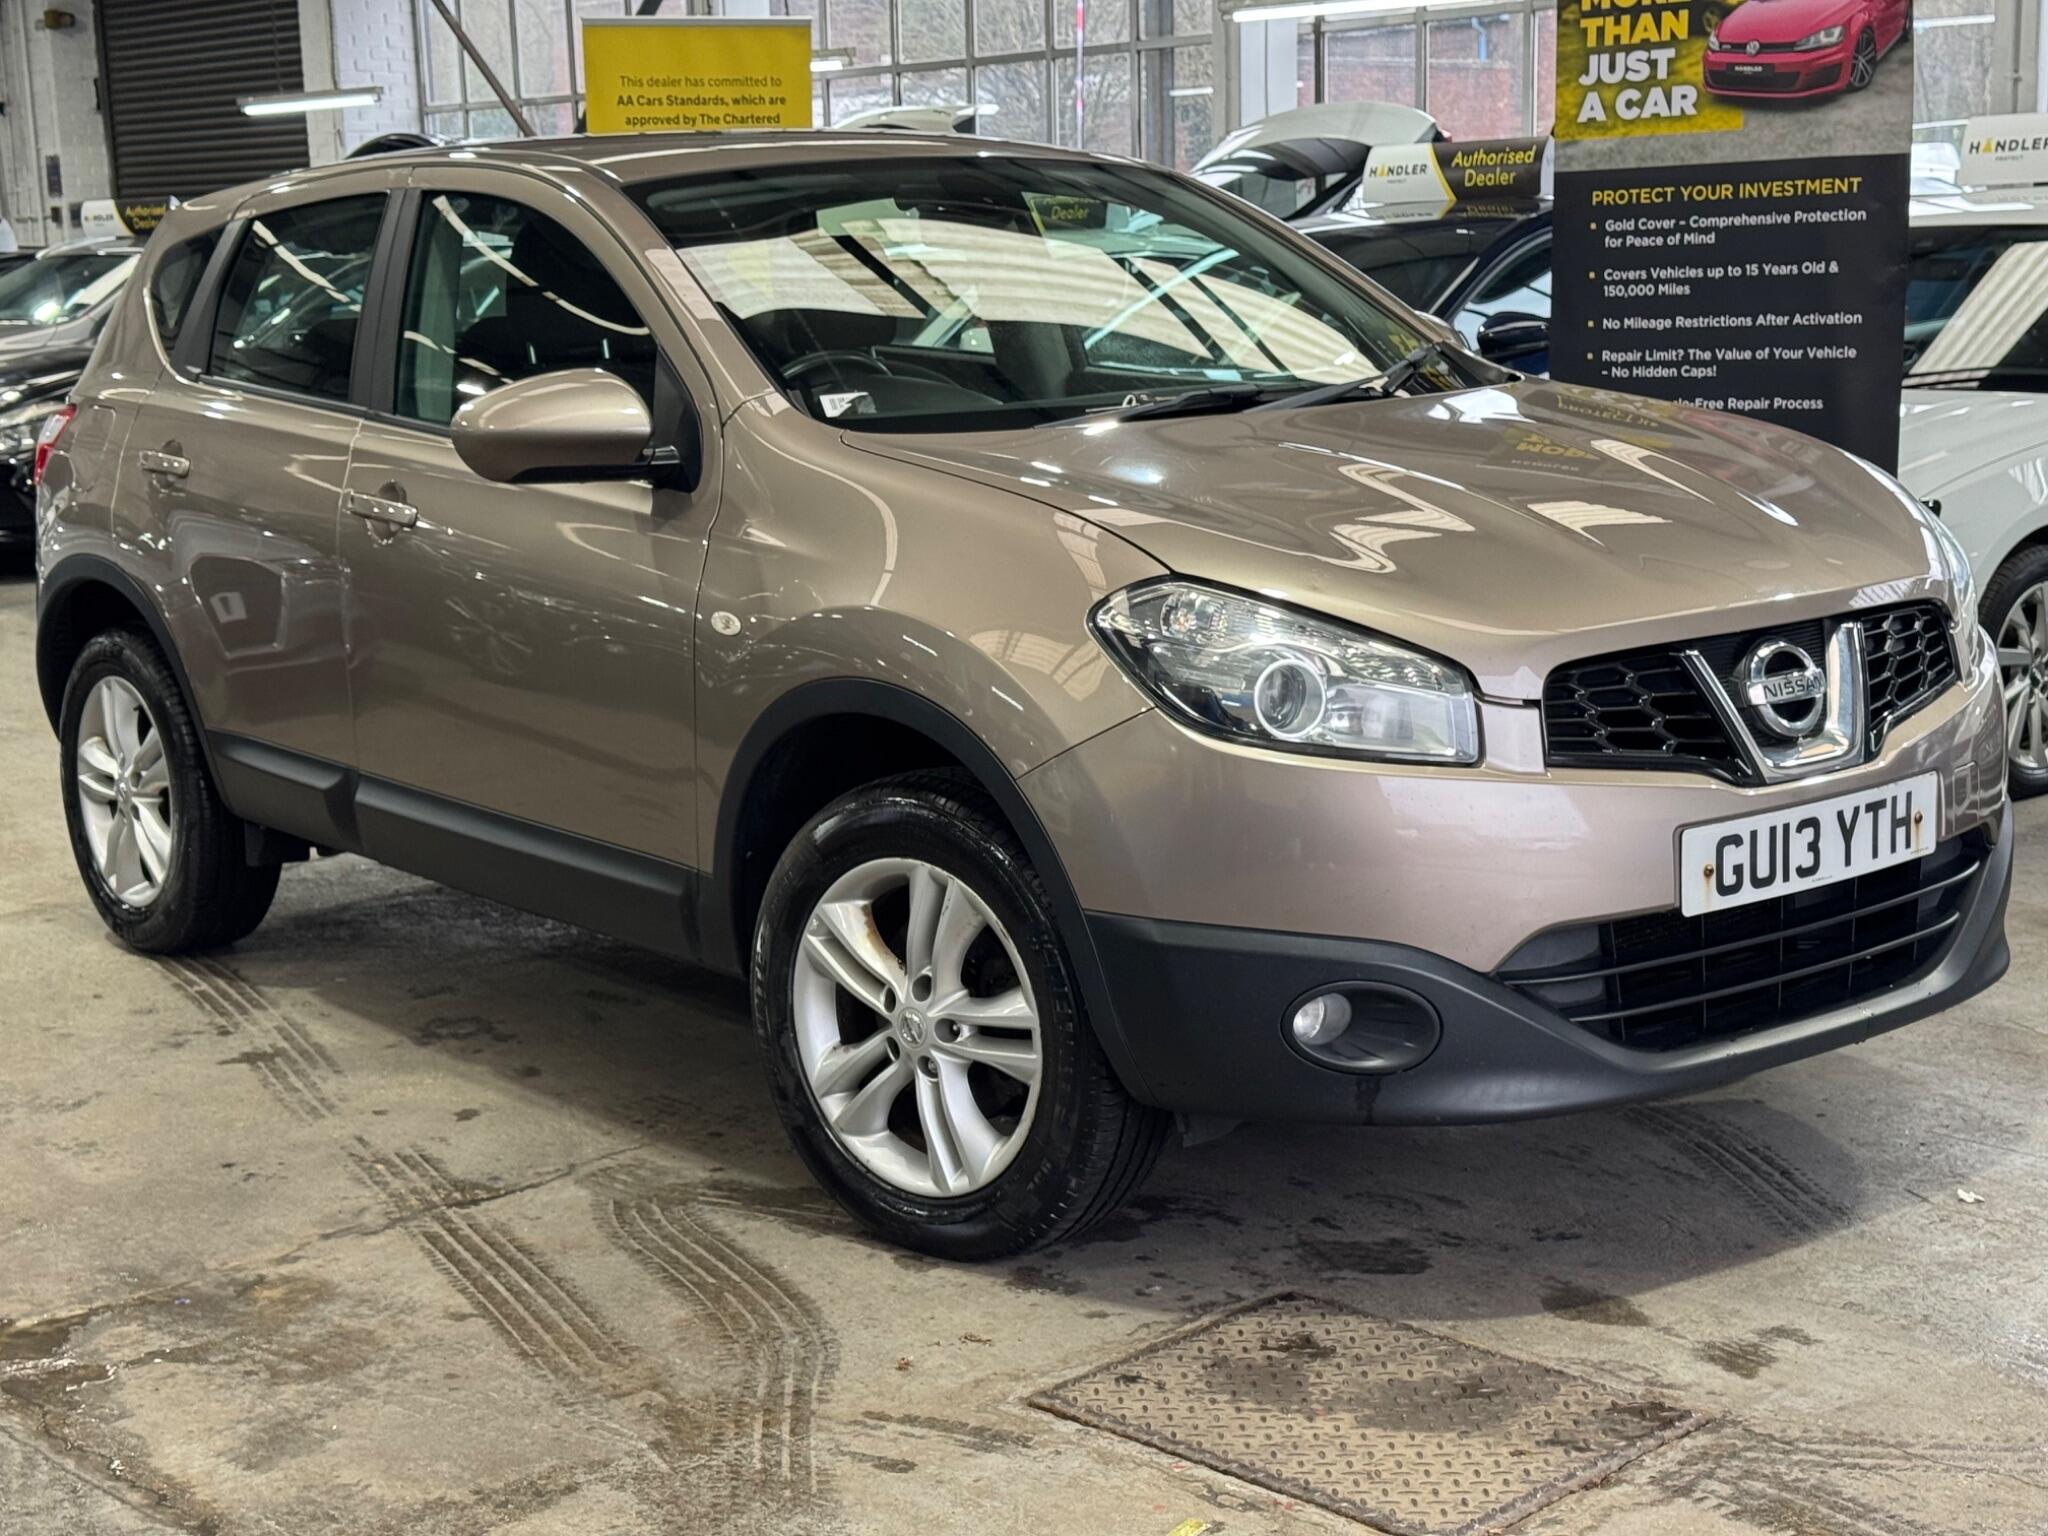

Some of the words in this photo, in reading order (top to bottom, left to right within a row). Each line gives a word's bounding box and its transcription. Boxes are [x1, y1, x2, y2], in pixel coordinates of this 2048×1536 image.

[1580, 9, 1689, 48] THAN
[1578, 48, 1676, 86] JUST
[620, 75, 644, 87] This
[646, 76, 682, 87] dealer
[685, 75, 705, 87] has
[708, 75, 766, 87] committed
[768, 75, 782, 87] to
[617, 96, 634, 106] AA
[636, 95, 664, 106] Cars
[666, 95, 729, 107] Standards,
[731, 95, 767, 106] which
[769, 96, 786, 106] are
[1576, 91, 1606, 123] A
[1615, 84, 1698, 121] CAR
[625, 115, 681, 127] approved
[683, 114, 697, 127] by
[699, 113, 721, 125] The
[723, 113, 780, 125] Chartered
[1452, 144, 1537, 168] Authorised
[1369, 163, 1428, 178] HANDLER
[1464, 167, 1517, 187] Dealer
[1592, 187, 1675, 206] PROTECT
[1680, 184, 1734, 202] YOUR
[1739, 177, 1863, 200] INVESTMENT
[1605, 217, 1635, 232] Gold
[1638, 216, 1676, 231] Cover
[1689, 211, 1792, 230] Comprehensive
[1794, 208, 1867, 223] Protection
[1604, 235, 1623, 248] for
[1625, 233, 1664, 248] Peace
[1667, 233, 1681, 246] of
[1683, 231, 1716, 246] Mind
[1604, 267, 1648, 281] Covers
[1650, 265, 1704, 280] Vehicles
[1707, 266, 1725, 280] up
[1727, 264, 1742, 278] to
[1745, 263, 1759, 277] 15
[1762, 262, 1799, 276] Years
[1801, 260, 1826, 274] Old
[1828, 261, 1839, 274] &
[1603, 283, 1655, 299] 150,000
[1658, 282, 1691, 297] Miles
[1602, 317, 1621, 330] No
[1623, 316, 1673, 331] Mileage
[1675, 314, 1753, 329] Restrictions
[1755, 312, 1790, 327] After
[1792, 311, 1863, 326] Activation
[1602, 349, 1642, 364] Repair
[1645, 348, 1685, 362] Limit?
[1688, 348, 1712, 361] The
[1715, 347, 1753, 361] Value
[1755, 346, 1770, 360] of
[1773, 346, 1805, 360] Your
[1806, 345, 1857, 360] Vehicle
[1611, 366, 1630, 379] No
[1633, 365, 1678, 379] Hidden
[1681, 364, 1717, 380] Caps!
[1727, 397, 1770, 411] Repair
[1773, 397, 1824, 410] Process
[1763, 675, 1826, 699] NISSAN
[1715, 816, 1821, 897] GU13
[1837, 790, 1913, 867] YTH
